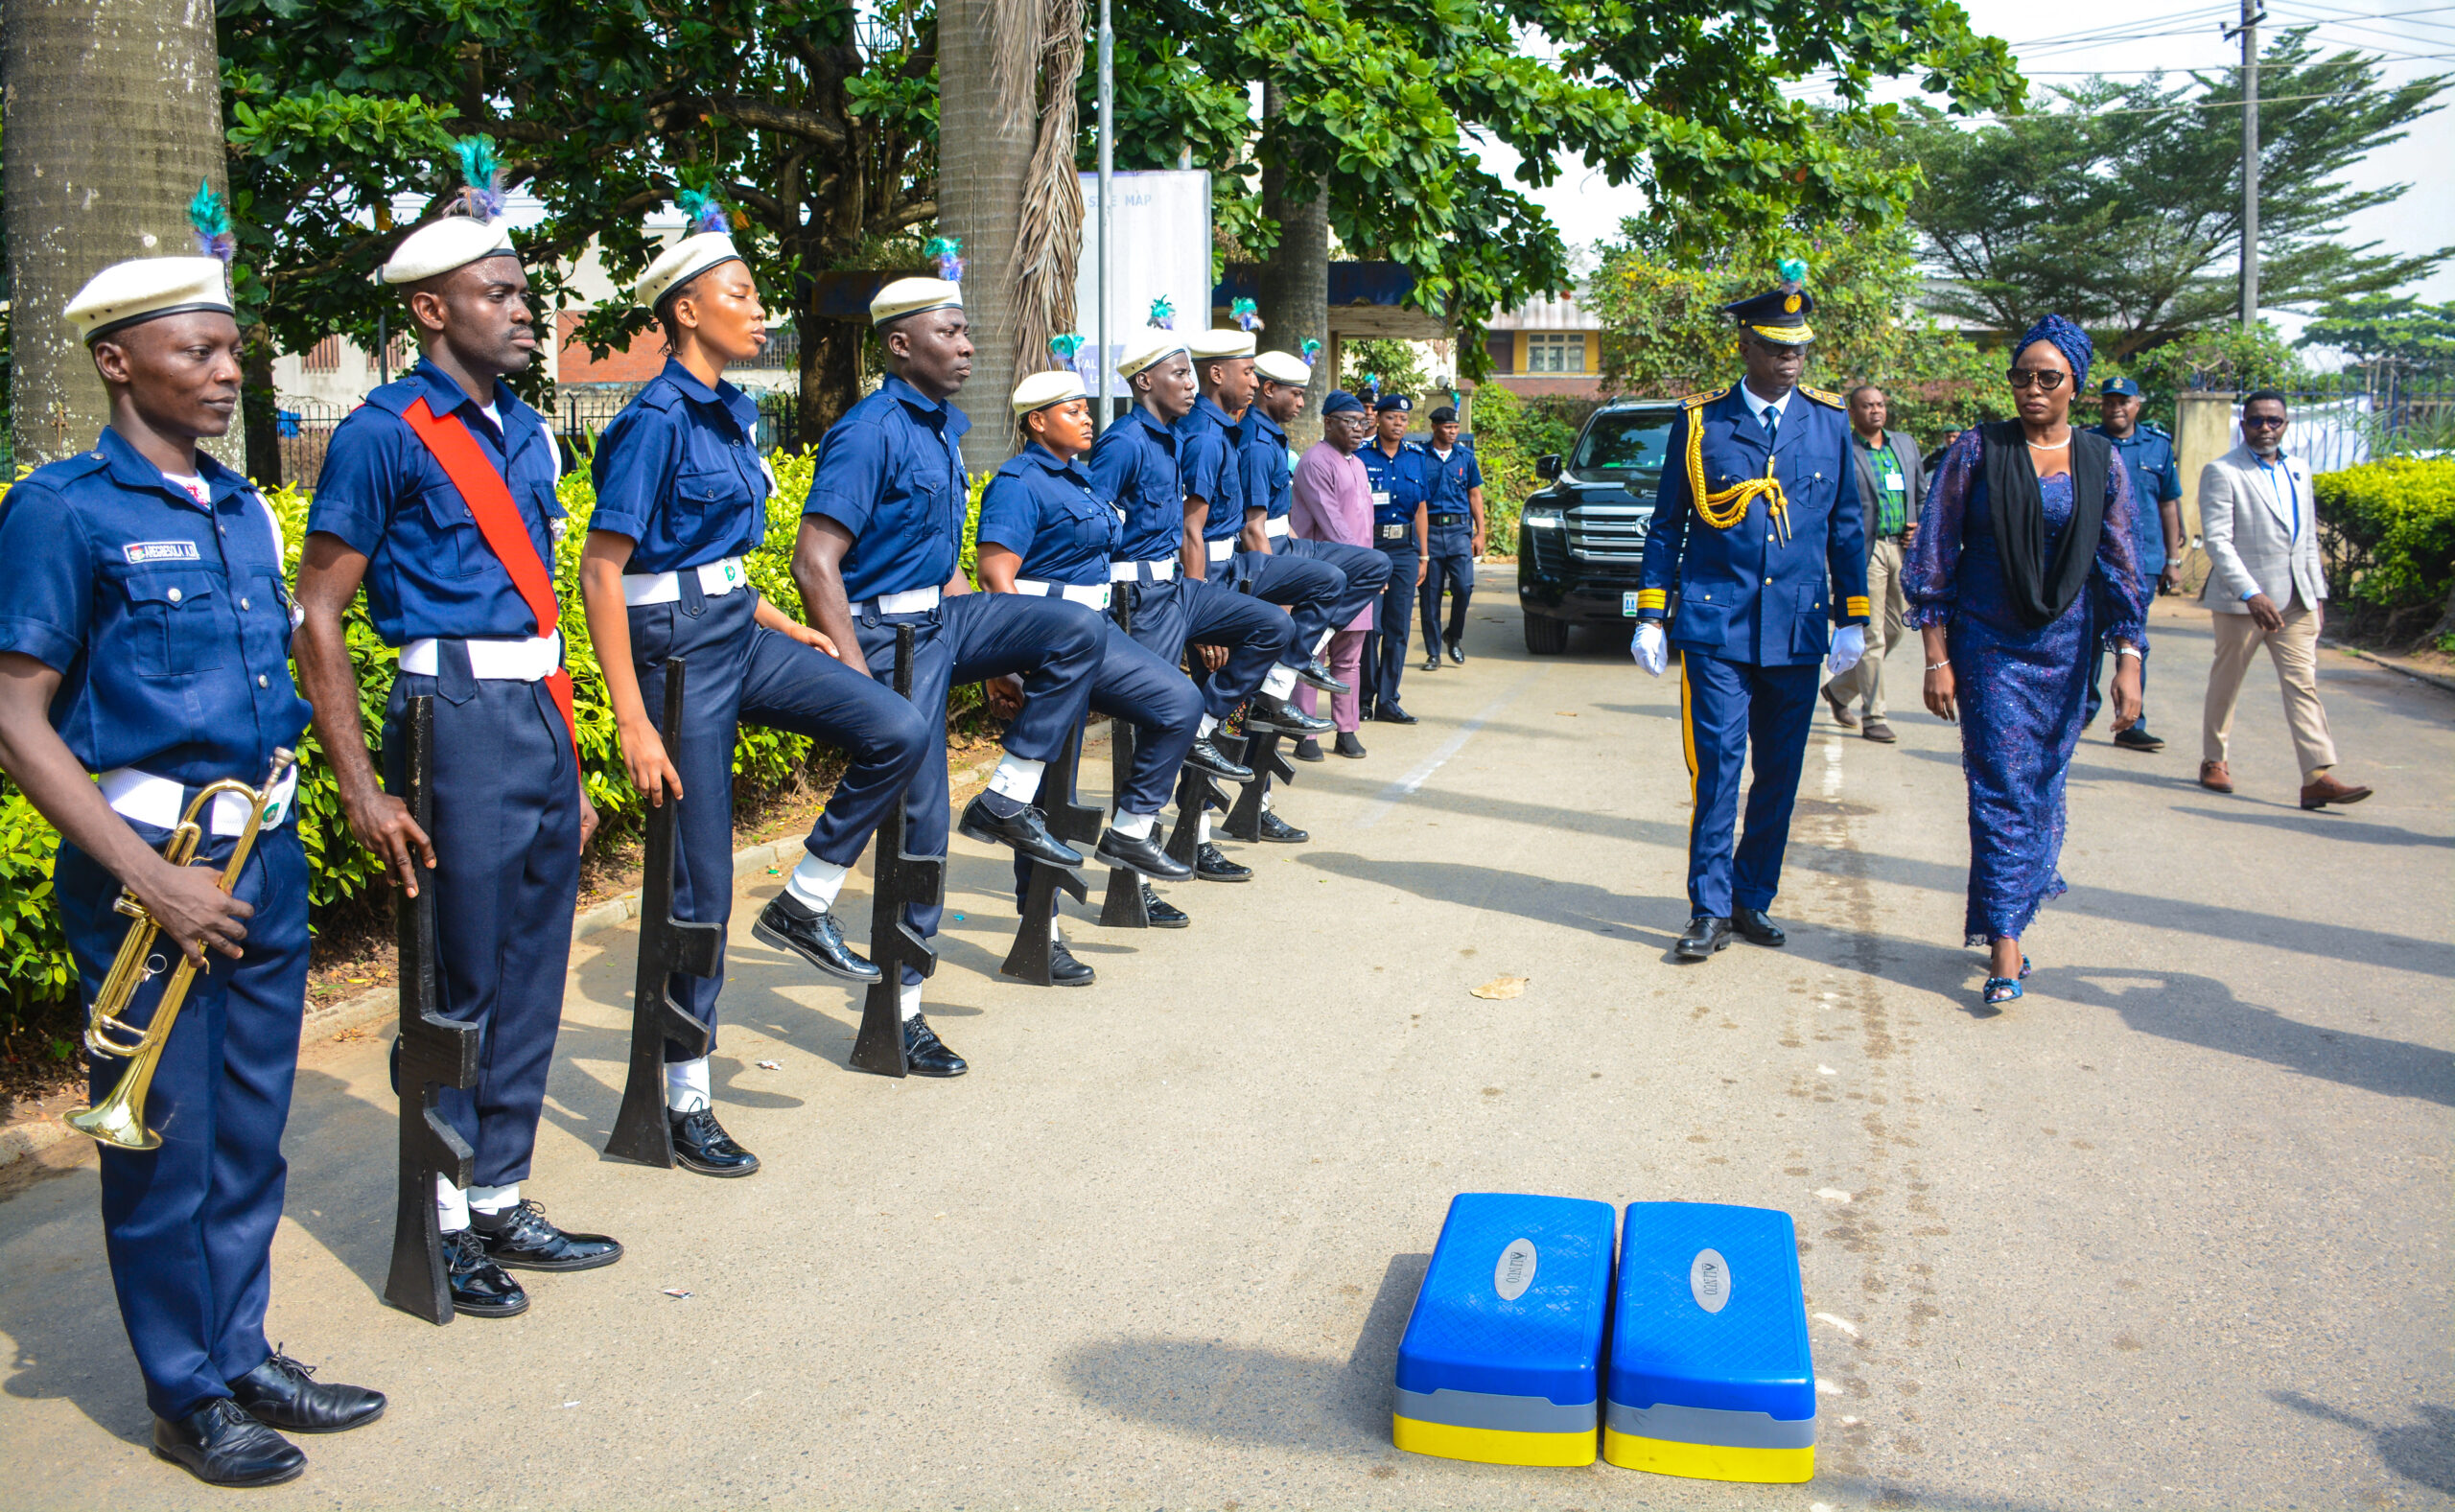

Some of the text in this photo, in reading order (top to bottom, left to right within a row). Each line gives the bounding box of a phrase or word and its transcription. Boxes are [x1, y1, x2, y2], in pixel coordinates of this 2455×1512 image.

[1088, 194, 1152, 208] SE MAP
[1089, 373, 1120, 384] Las
